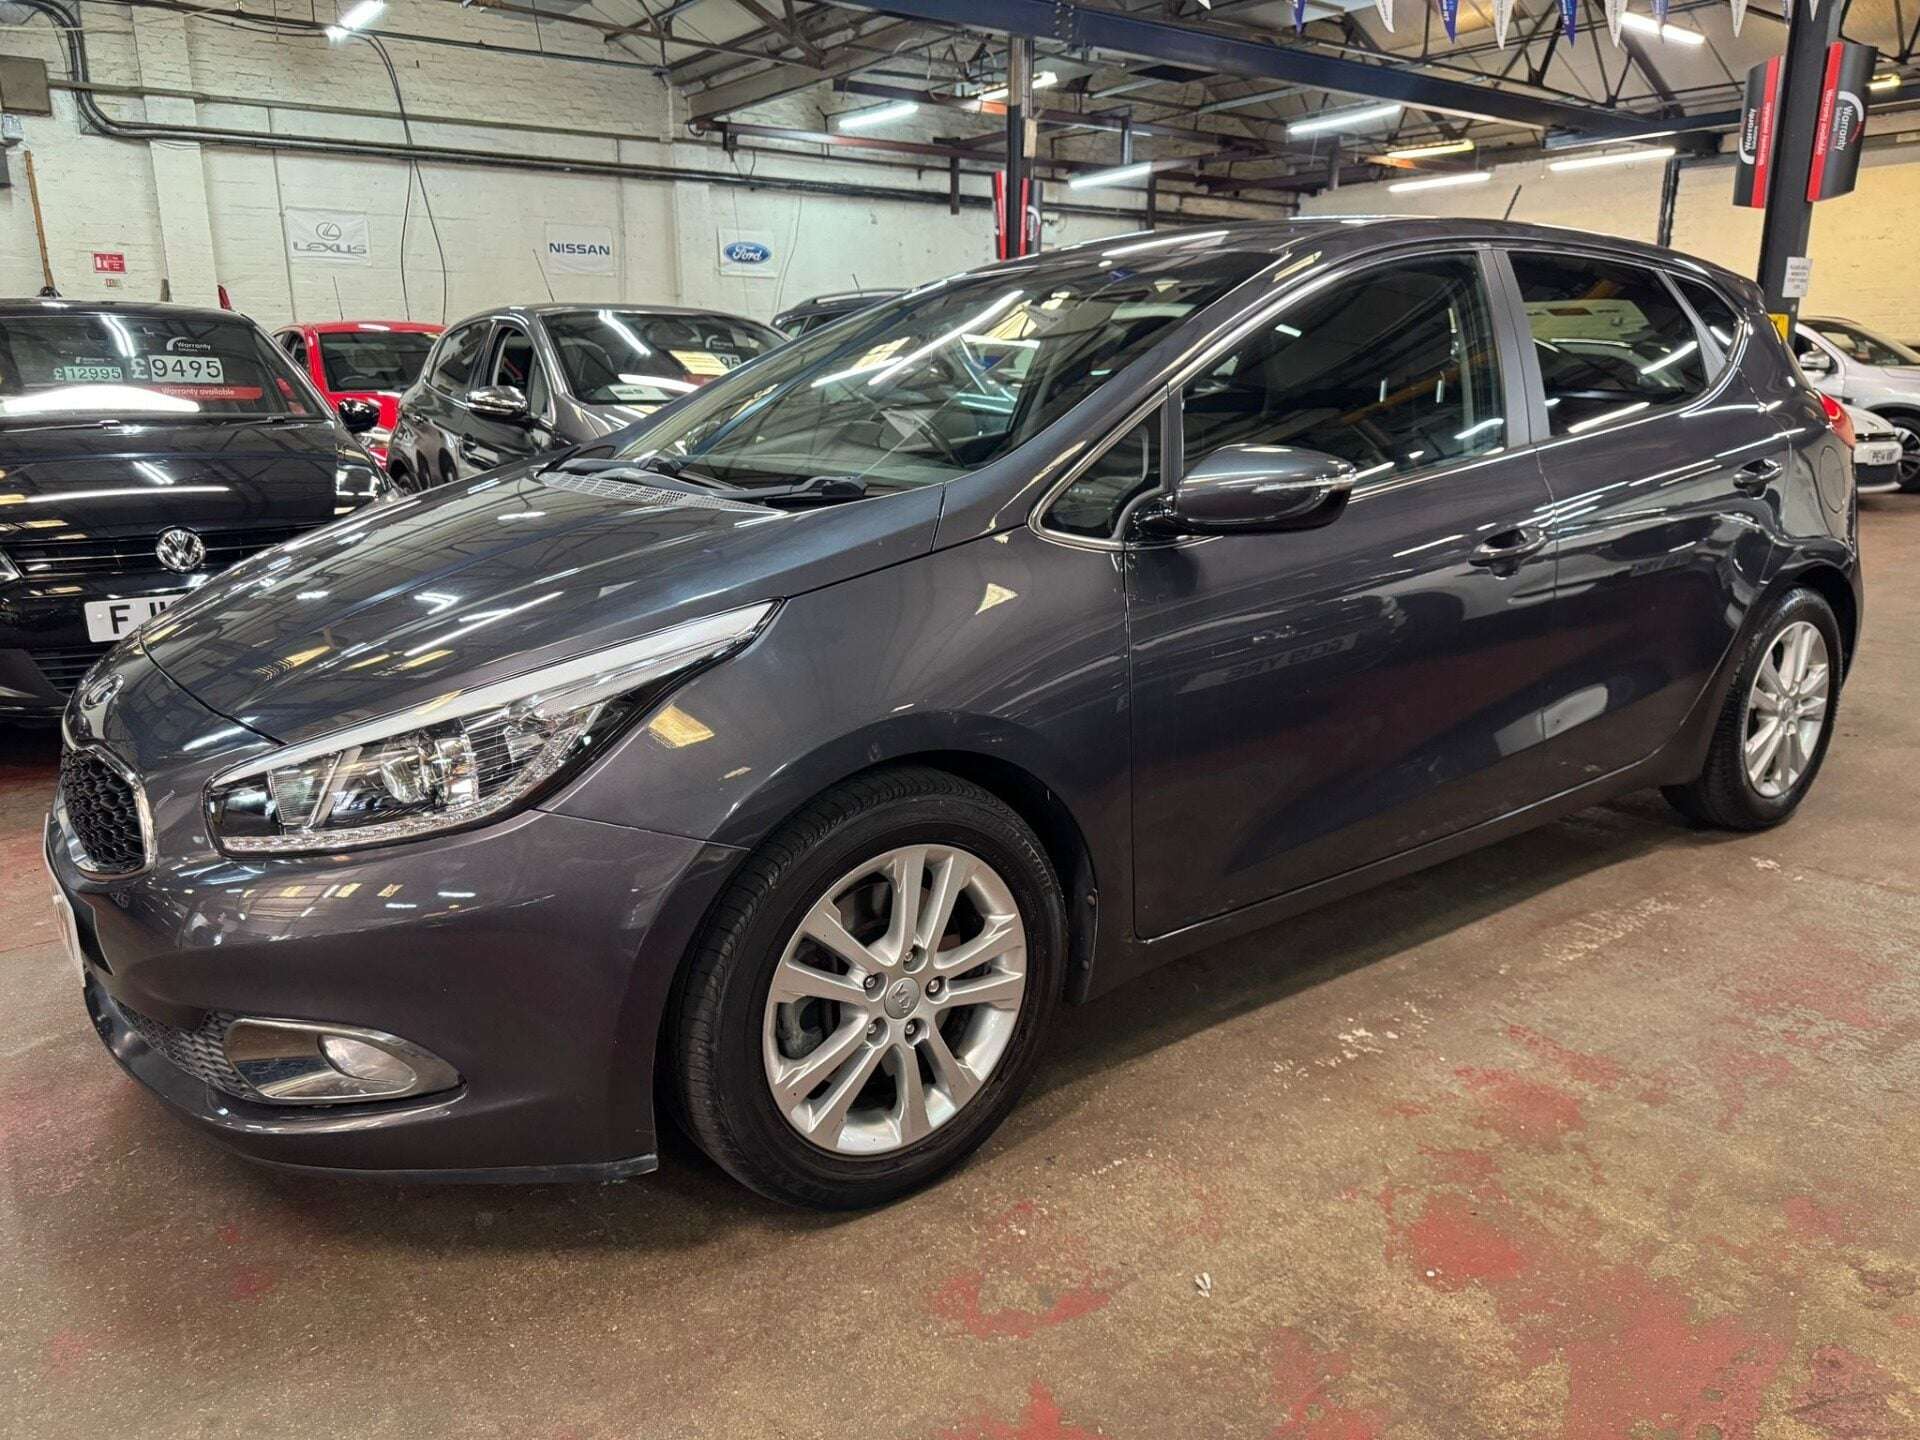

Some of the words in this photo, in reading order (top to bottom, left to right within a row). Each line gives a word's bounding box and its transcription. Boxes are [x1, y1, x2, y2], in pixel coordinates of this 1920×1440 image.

[1744, 107, 1757, 151] Warranty
[1834, 106, 1854, 151] Warranty
[293, 241, 366, 254] LEXUS
[549, 242, 610, 255] NISSAN
[732, 244, 763, 260] Ford
[176, 341, 211, 351] Warranty
[130, 357, 221, 379] £9495
[161, 386, 198, 397] Warranty
[199, 387, 235, 396] available
